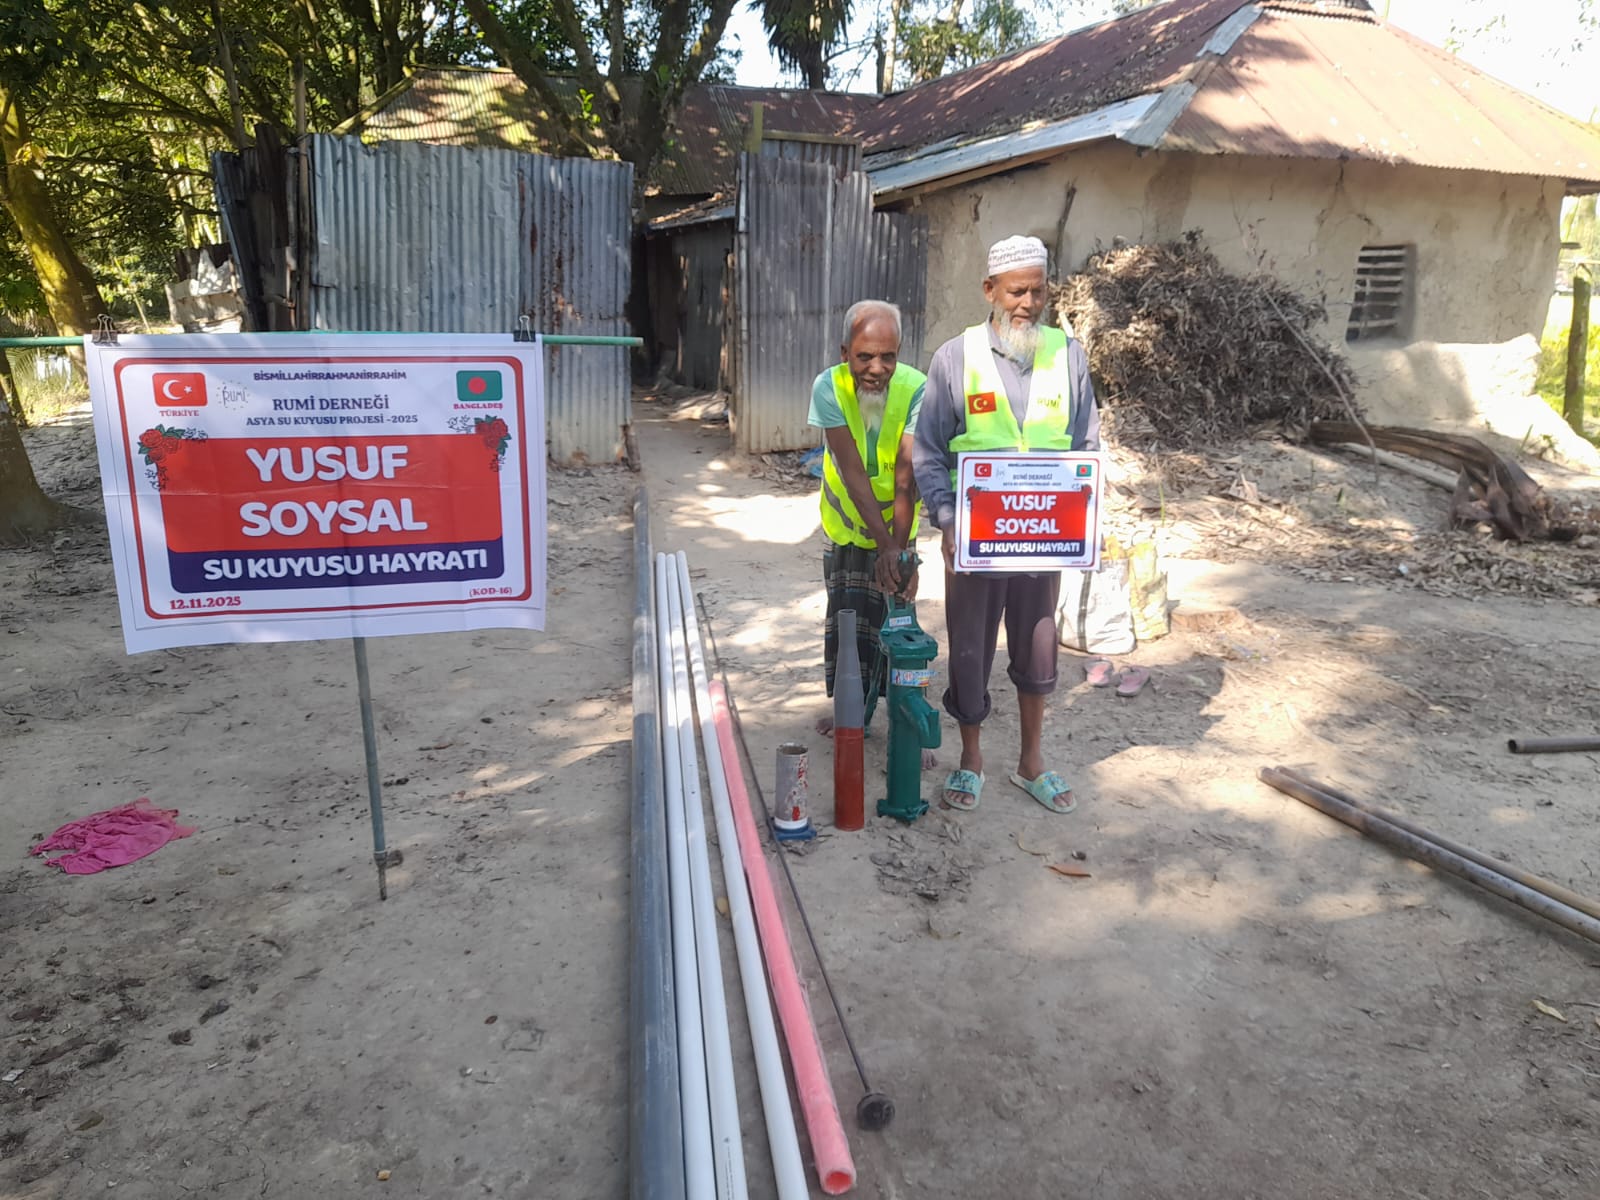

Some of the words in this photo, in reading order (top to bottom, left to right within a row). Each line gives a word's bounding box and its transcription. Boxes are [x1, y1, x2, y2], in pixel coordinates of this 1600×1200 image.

[253, 369, 407, 381] BİSMİLLAHİRRAHMANİRRAHİM
[272, 395, 315, 411] RUMİ
[319, 394, 390, 411] DERNEĞİ
[453, 402, 503, 410] BANGLADEŞ
[159, 409, 199, 417] TÜRKİYE
[246, 417, 276, 426] ASYA
[277, 416, 291, 425] SU
[293, 416, 337, 425] KUYUSU
[339, 413, 384, 424] PROJESİ
[245, 445, 409, 482] YUSUF
[1001, 495, 1057, 511] YUSUF
[239, 498, 428, 537] SOYSAL
[994, 518, 1060, 534] SOYSAL
[979, 542, 994, 553] SU
[994, 542, 1036, 553] KUYUSU
[1037, 542, 1080, 553] HAYRATI
[203, 558, 243, 581] SU
[247, 554, 364, 580] KUYUSU
[369, 549, 488, 574] HAYRATI
[169, 595, 241, 610] 12.11.2025
